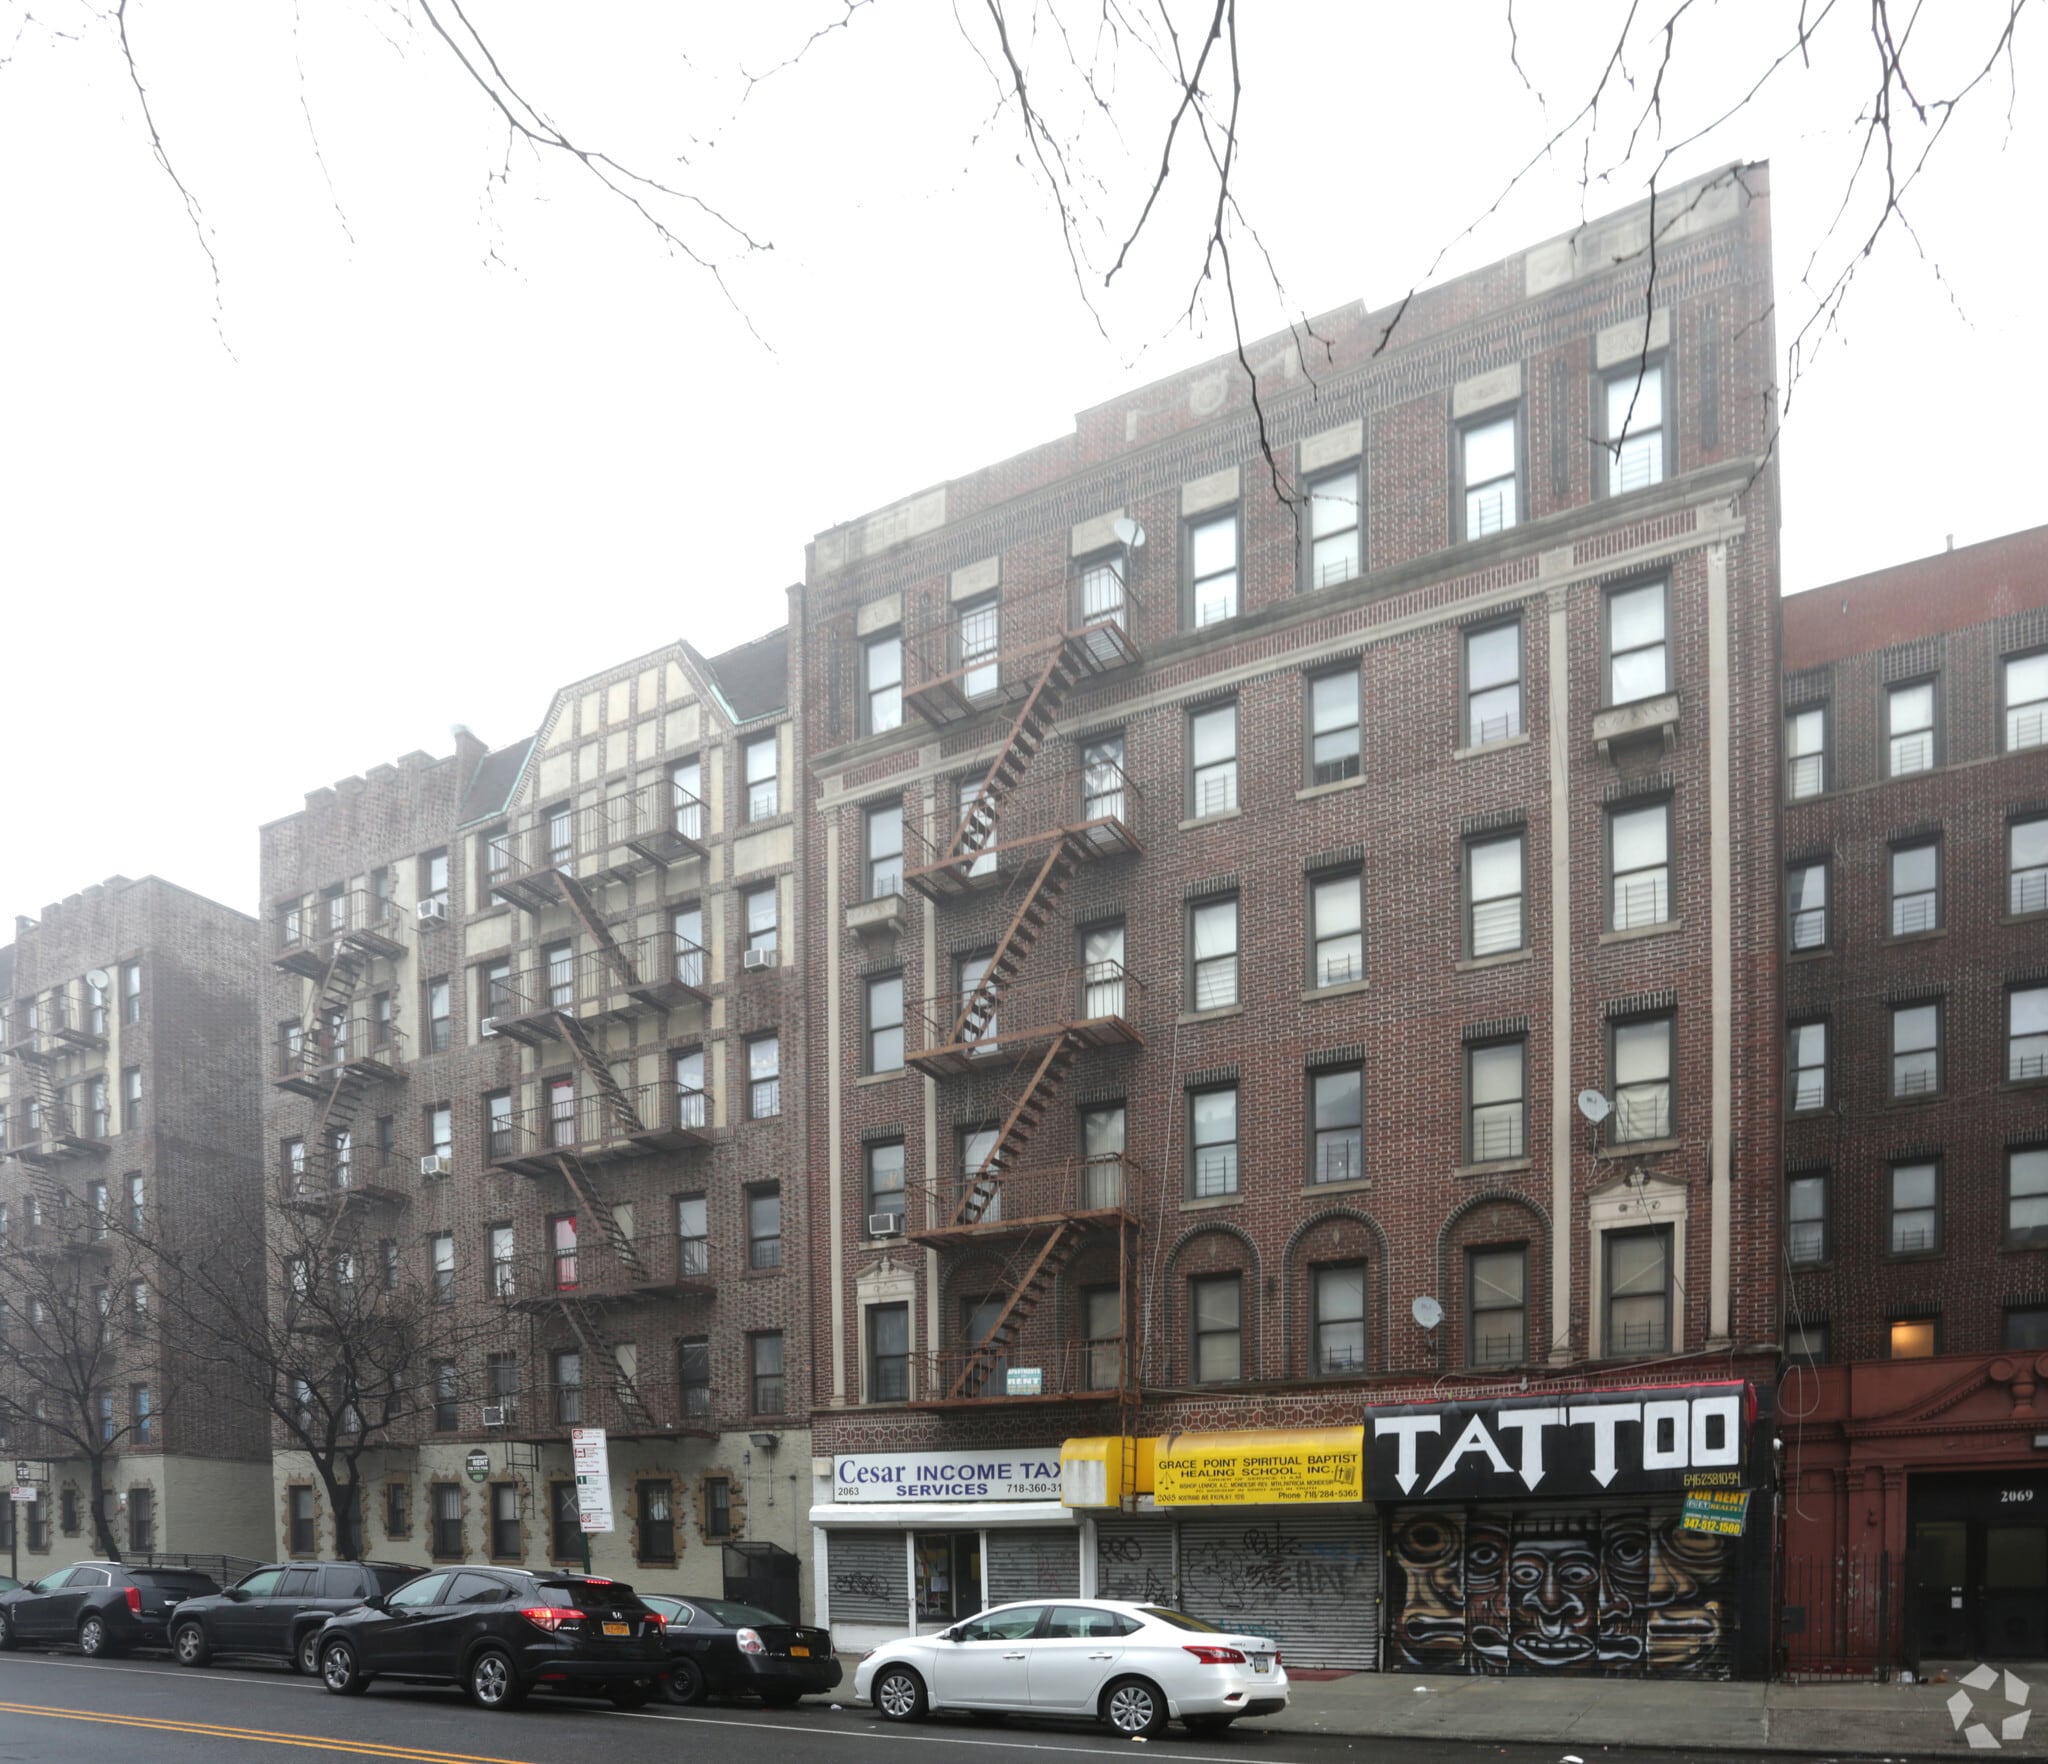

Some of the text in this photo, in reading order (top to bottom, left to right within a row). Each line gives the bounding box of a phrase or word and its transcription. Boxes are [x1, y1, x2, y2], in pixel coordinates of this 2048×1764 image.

[1374, 1396, 1740, 1497] TATTOO
[1158, 1454, 1358, 1470] GRACE POINT SPIRITUAL BAPTIST
[838, 1460, 906, 1484] Cesar
[916, 1463, 1012, 1481] INCOME
[1180, 1468, 1235, 1478] HEALING
[1307, 1464, 1334, 1474] INC.
[838, 1487, 860, 1496] 2063
[896, 1483, 988, 1497] SERVICES
[1006, 1483, 1062, 1493] 718-360-31
[1278, 1489, 1359, 1499] Phone 718/284-5365
[1157, 1494, 1177, 1502] 2065
[1688, 1490, 1712, 1501] FOR
[1714, 1491, 1748, 1505] RENT
[2000, 1490, 2034, 1502] 2069
